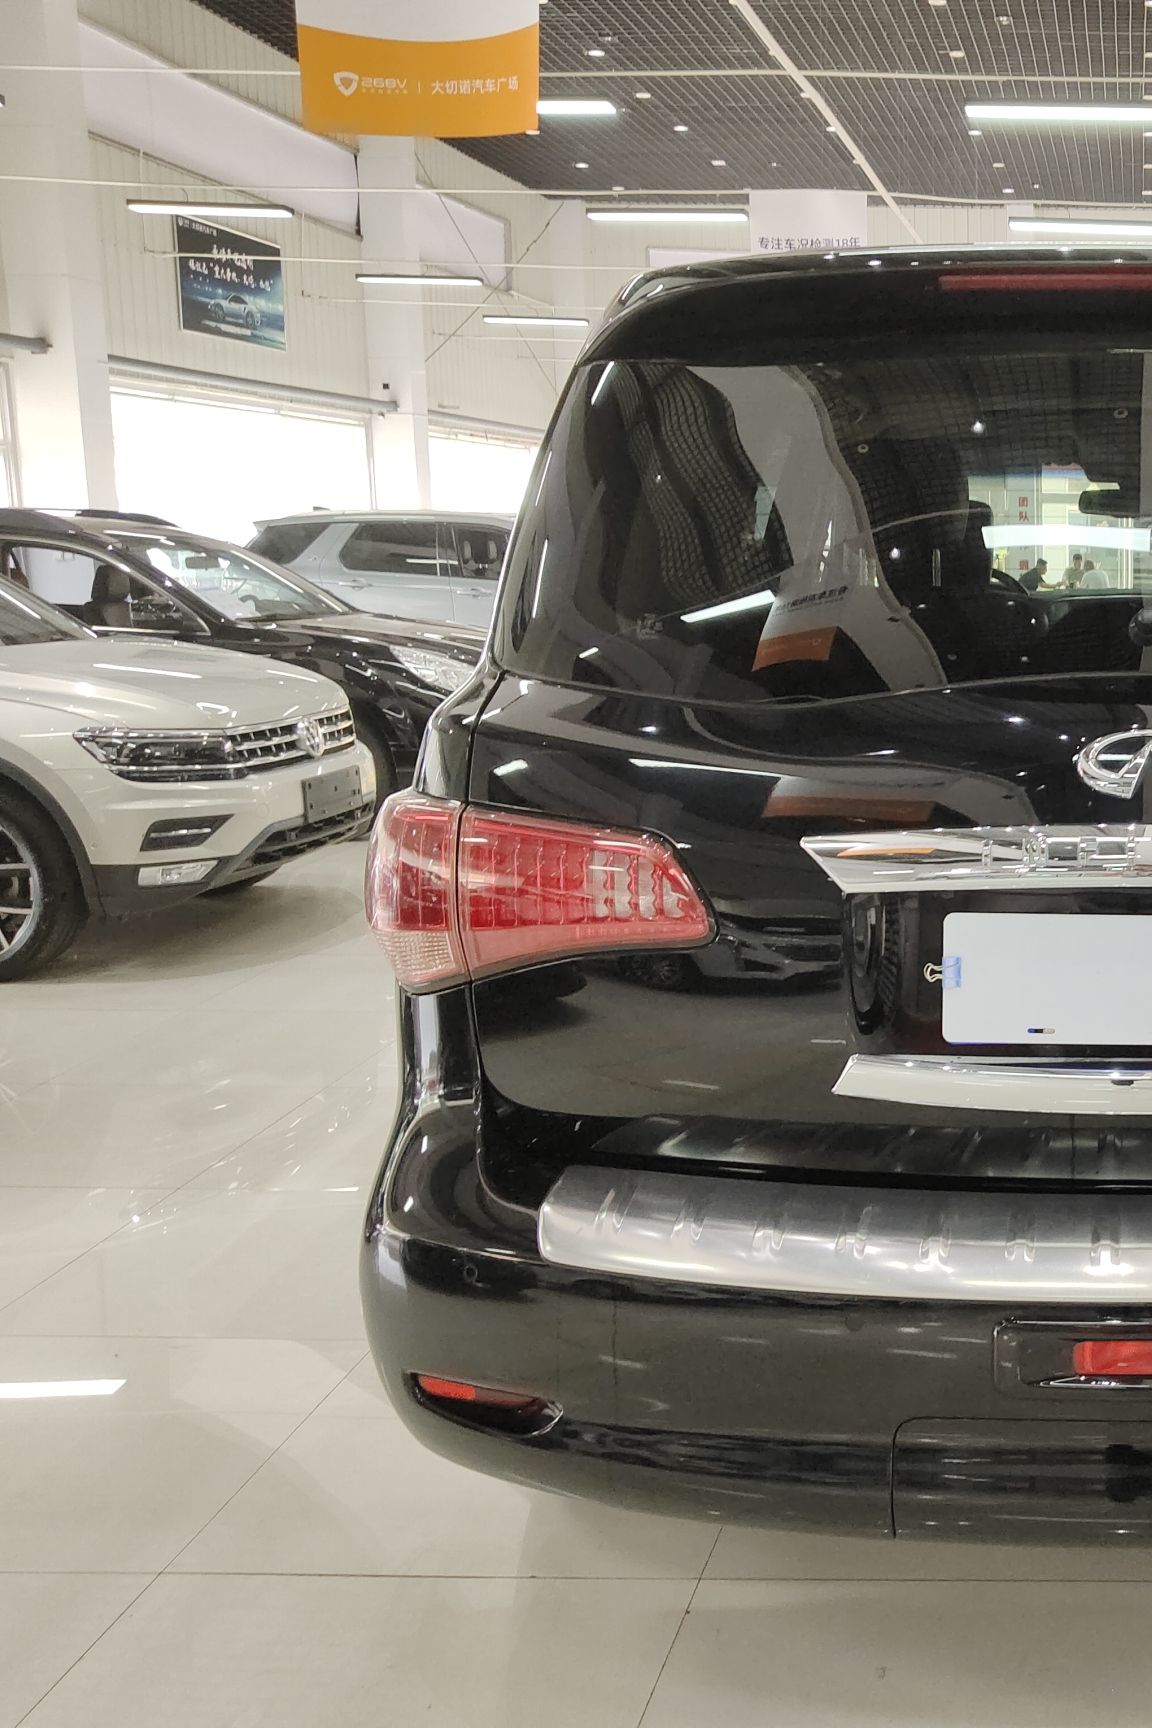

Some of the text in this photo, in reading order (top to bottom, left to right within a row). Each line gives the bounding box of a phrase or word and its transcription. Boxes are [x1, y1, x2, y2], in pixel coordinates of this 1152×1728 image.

[431, 75, 520, 96] 大切诺汽车广场
[759, 236, 861, 250] 专注车况检测18年
